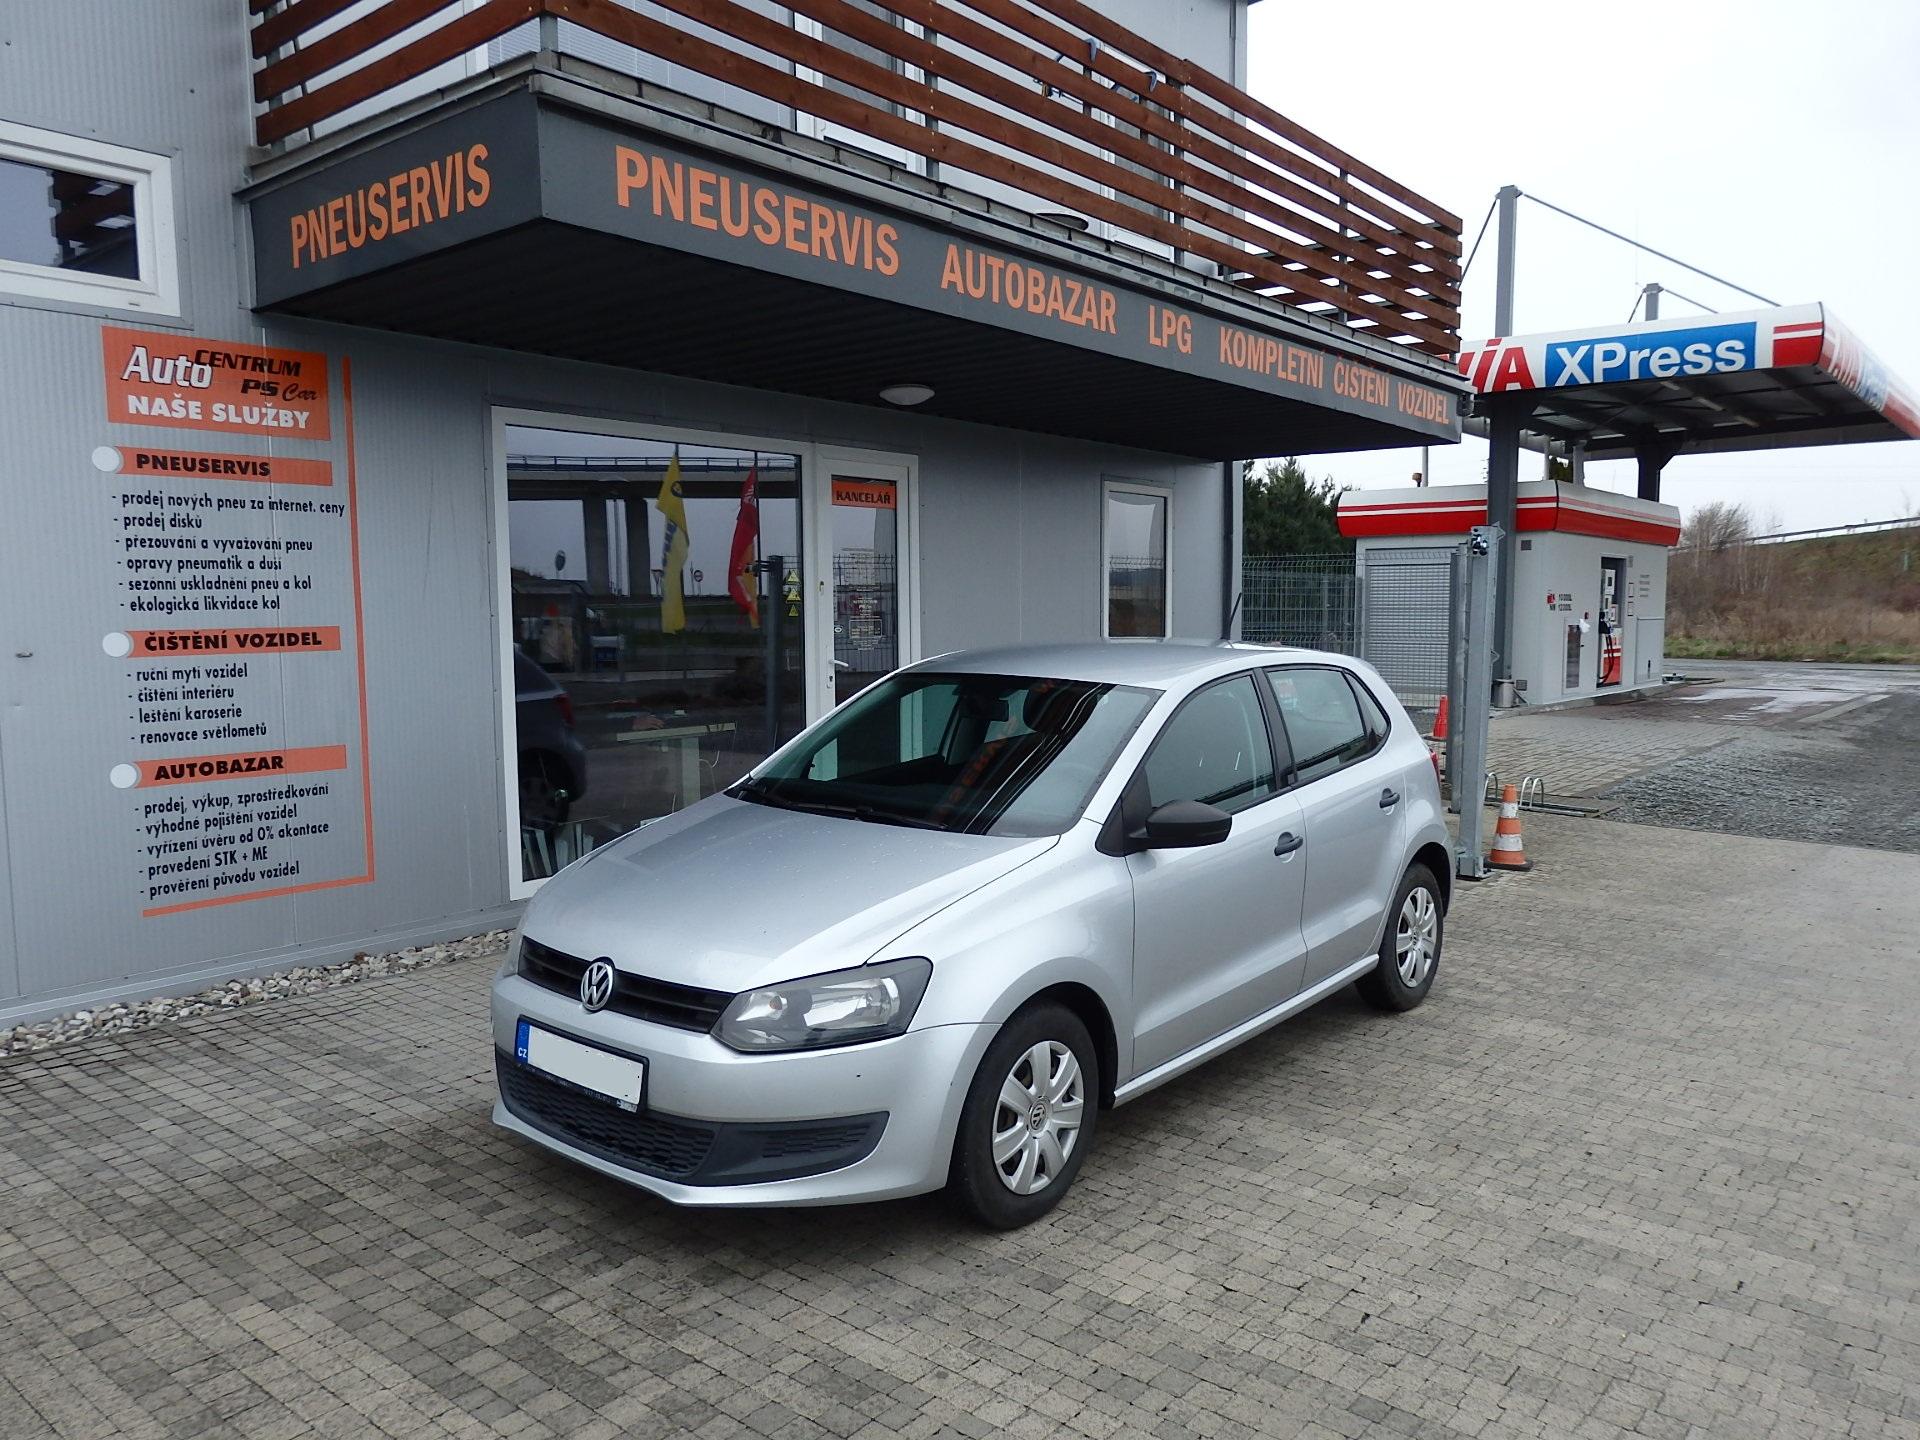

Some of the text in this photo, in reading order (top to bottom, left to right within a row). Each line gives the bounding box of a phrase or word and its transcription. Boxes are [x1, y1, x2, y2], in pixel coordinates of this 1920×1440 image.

[291, 144, 490, 268] PNEUSERVIS
[614, 145, 899, 276] PNEUSERVIS
[941, 244, 1117, 335] AUTOBAZAR
[1148, 304, 1192, 354] LPG
[1219, 326, 1325, 389] KOMPLETNÍ
[1397, 381, 1449, 425] VOZIDEL
[120, 344, 302, 390] Auto CENTRUM
[1554, 339, 1746, 387] XPress
[240, 378, 319, 402] PS Car
[127, 392, 310, 429] NAŠE SLUŽBY
[136, 453, 271, 477] PNEUSERVIS
[122, 489, 345, 517] prodej nových pneu za internet. ceny
[836, 490, 891, 504] KANCELÁŘ
[124, 512, 165, 531] prodej
[201, 540, 208, 549] a
[286, 541, 313, 554] pneu
[127, 559, 173, 573] opravy
[177, 555, 243, 573] pneumatik
[248, 560, 255, 569] a
[251, 580, 279, 593] pneu
[283, 580, 290, 589] a
[294, 575, 312, 589] kol
[130, 594, 280, 615] ekologická likvidace kol
[144, 630, 323, 651] ČIŠTĚNÍ VOZIDEL
[205, 662, 248, 679] vozidel
[137, 684, 235, 702] čištění interiéru
[139, 703, 243, 723] leštění karoserie
[140, 722, 267, 744] renovace světlometů
[154, 755, 284, 781] AUTOBAZAR
[144, 782, 329, 818] prodej, výkup, zprostředkování
[145, 816, 200, 838] výhodné
[257, 803, 298, 822] vozidel
[202, 834, 235, 848] úvěru
[240, 828, 254, 843] od
[257, 825, 274, 841] 0%
[278, 823, 330, 838] akontace
[148, 846, 268, 880] provedení STK + ME
[213, 868, 256, 890] původu
[260, 860, 300, 879] vozidel
[518, 1047, 527, 1058] CZ
